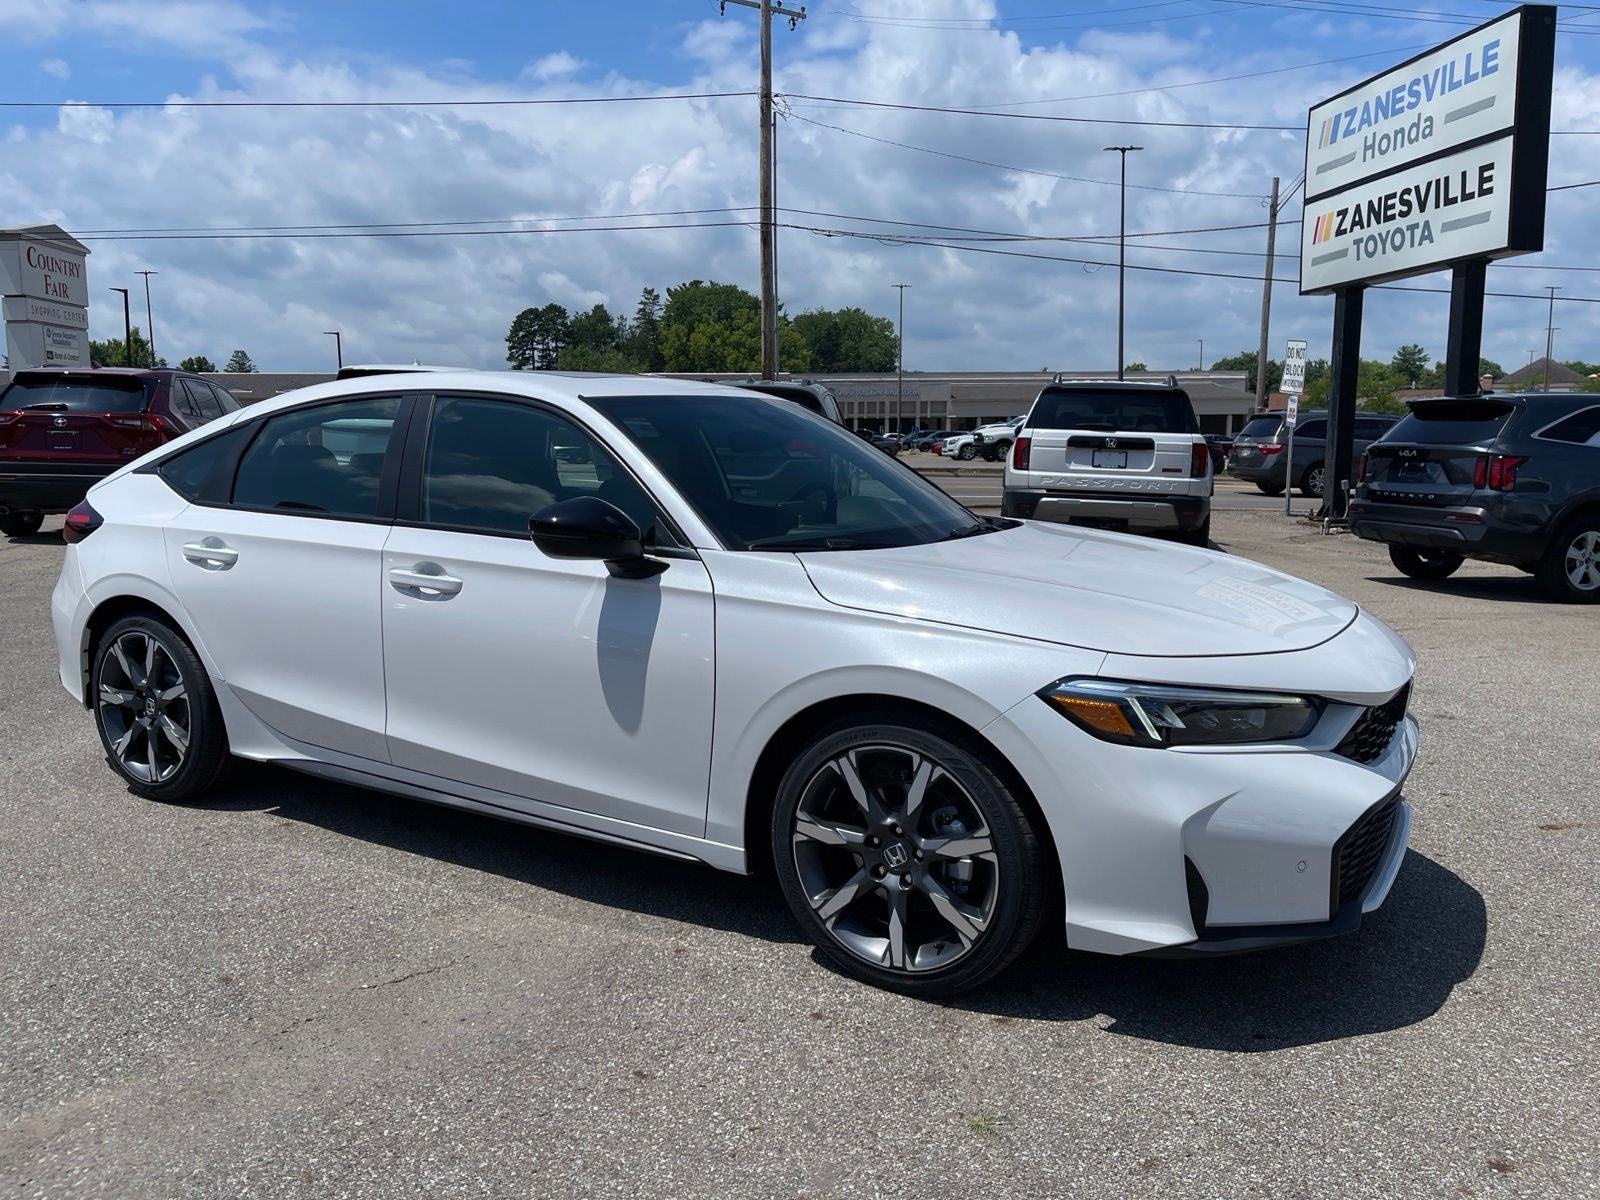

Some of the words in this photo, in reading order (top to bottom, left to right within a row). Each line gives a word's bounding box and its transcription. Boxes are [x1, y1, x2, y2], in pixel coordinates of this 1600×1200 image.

[1342, 39, 1500, 139] ZANESVILLE
[1362, 112, 1434, 163] Honda
[1334, 162, 1495, 237] ZANESVILLE
[1353, 220, 1434, 261] TOYOTA
[31, 304, 60, 320] SHOPPING
[63, 310, 85, 323] CENTER
[1287, 347, 1295, 359] DO
[1296, 348, 1306, 360] NOT
[1286, 364, 1305, 377] BLOCK
[1041, 476, 1178, 491] PASSPORT
